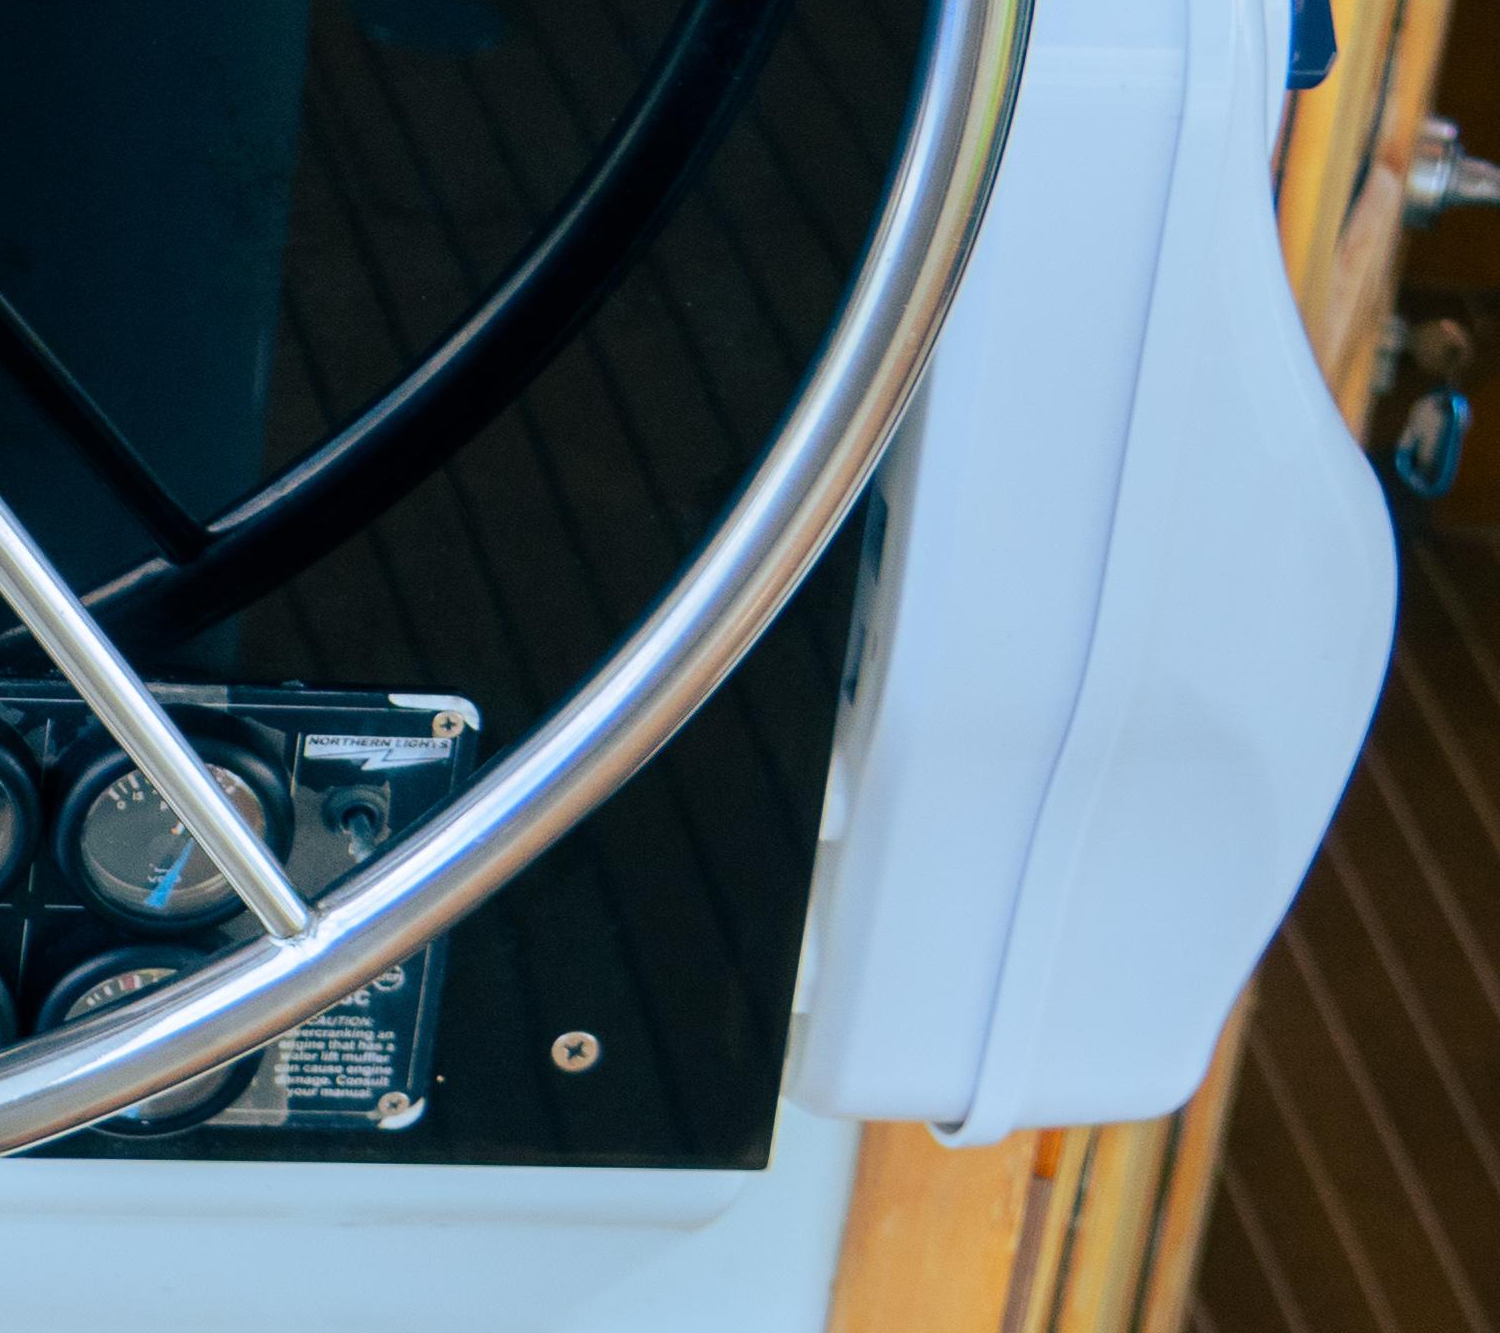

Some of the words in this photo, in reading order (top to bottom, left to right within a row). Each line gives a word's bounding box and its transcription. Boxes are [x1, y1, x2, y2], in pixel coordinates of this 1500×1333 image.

[308, 735, 391, 747] NORTHERN
[395, 738, 450, 749] LIGHTS
[377, 1030, 395, 1039] an
[328, 1039, 355, 1050] that
[357, 1040, 383, 1050] has
[386, 1042, 396, 1051] a
[302, 1064, 344, 1074] cause
[345, 1064, 394, 1076] engine
[335, 1074, 390, 1086] Consult
[285, 1088, 318, 1098] your
